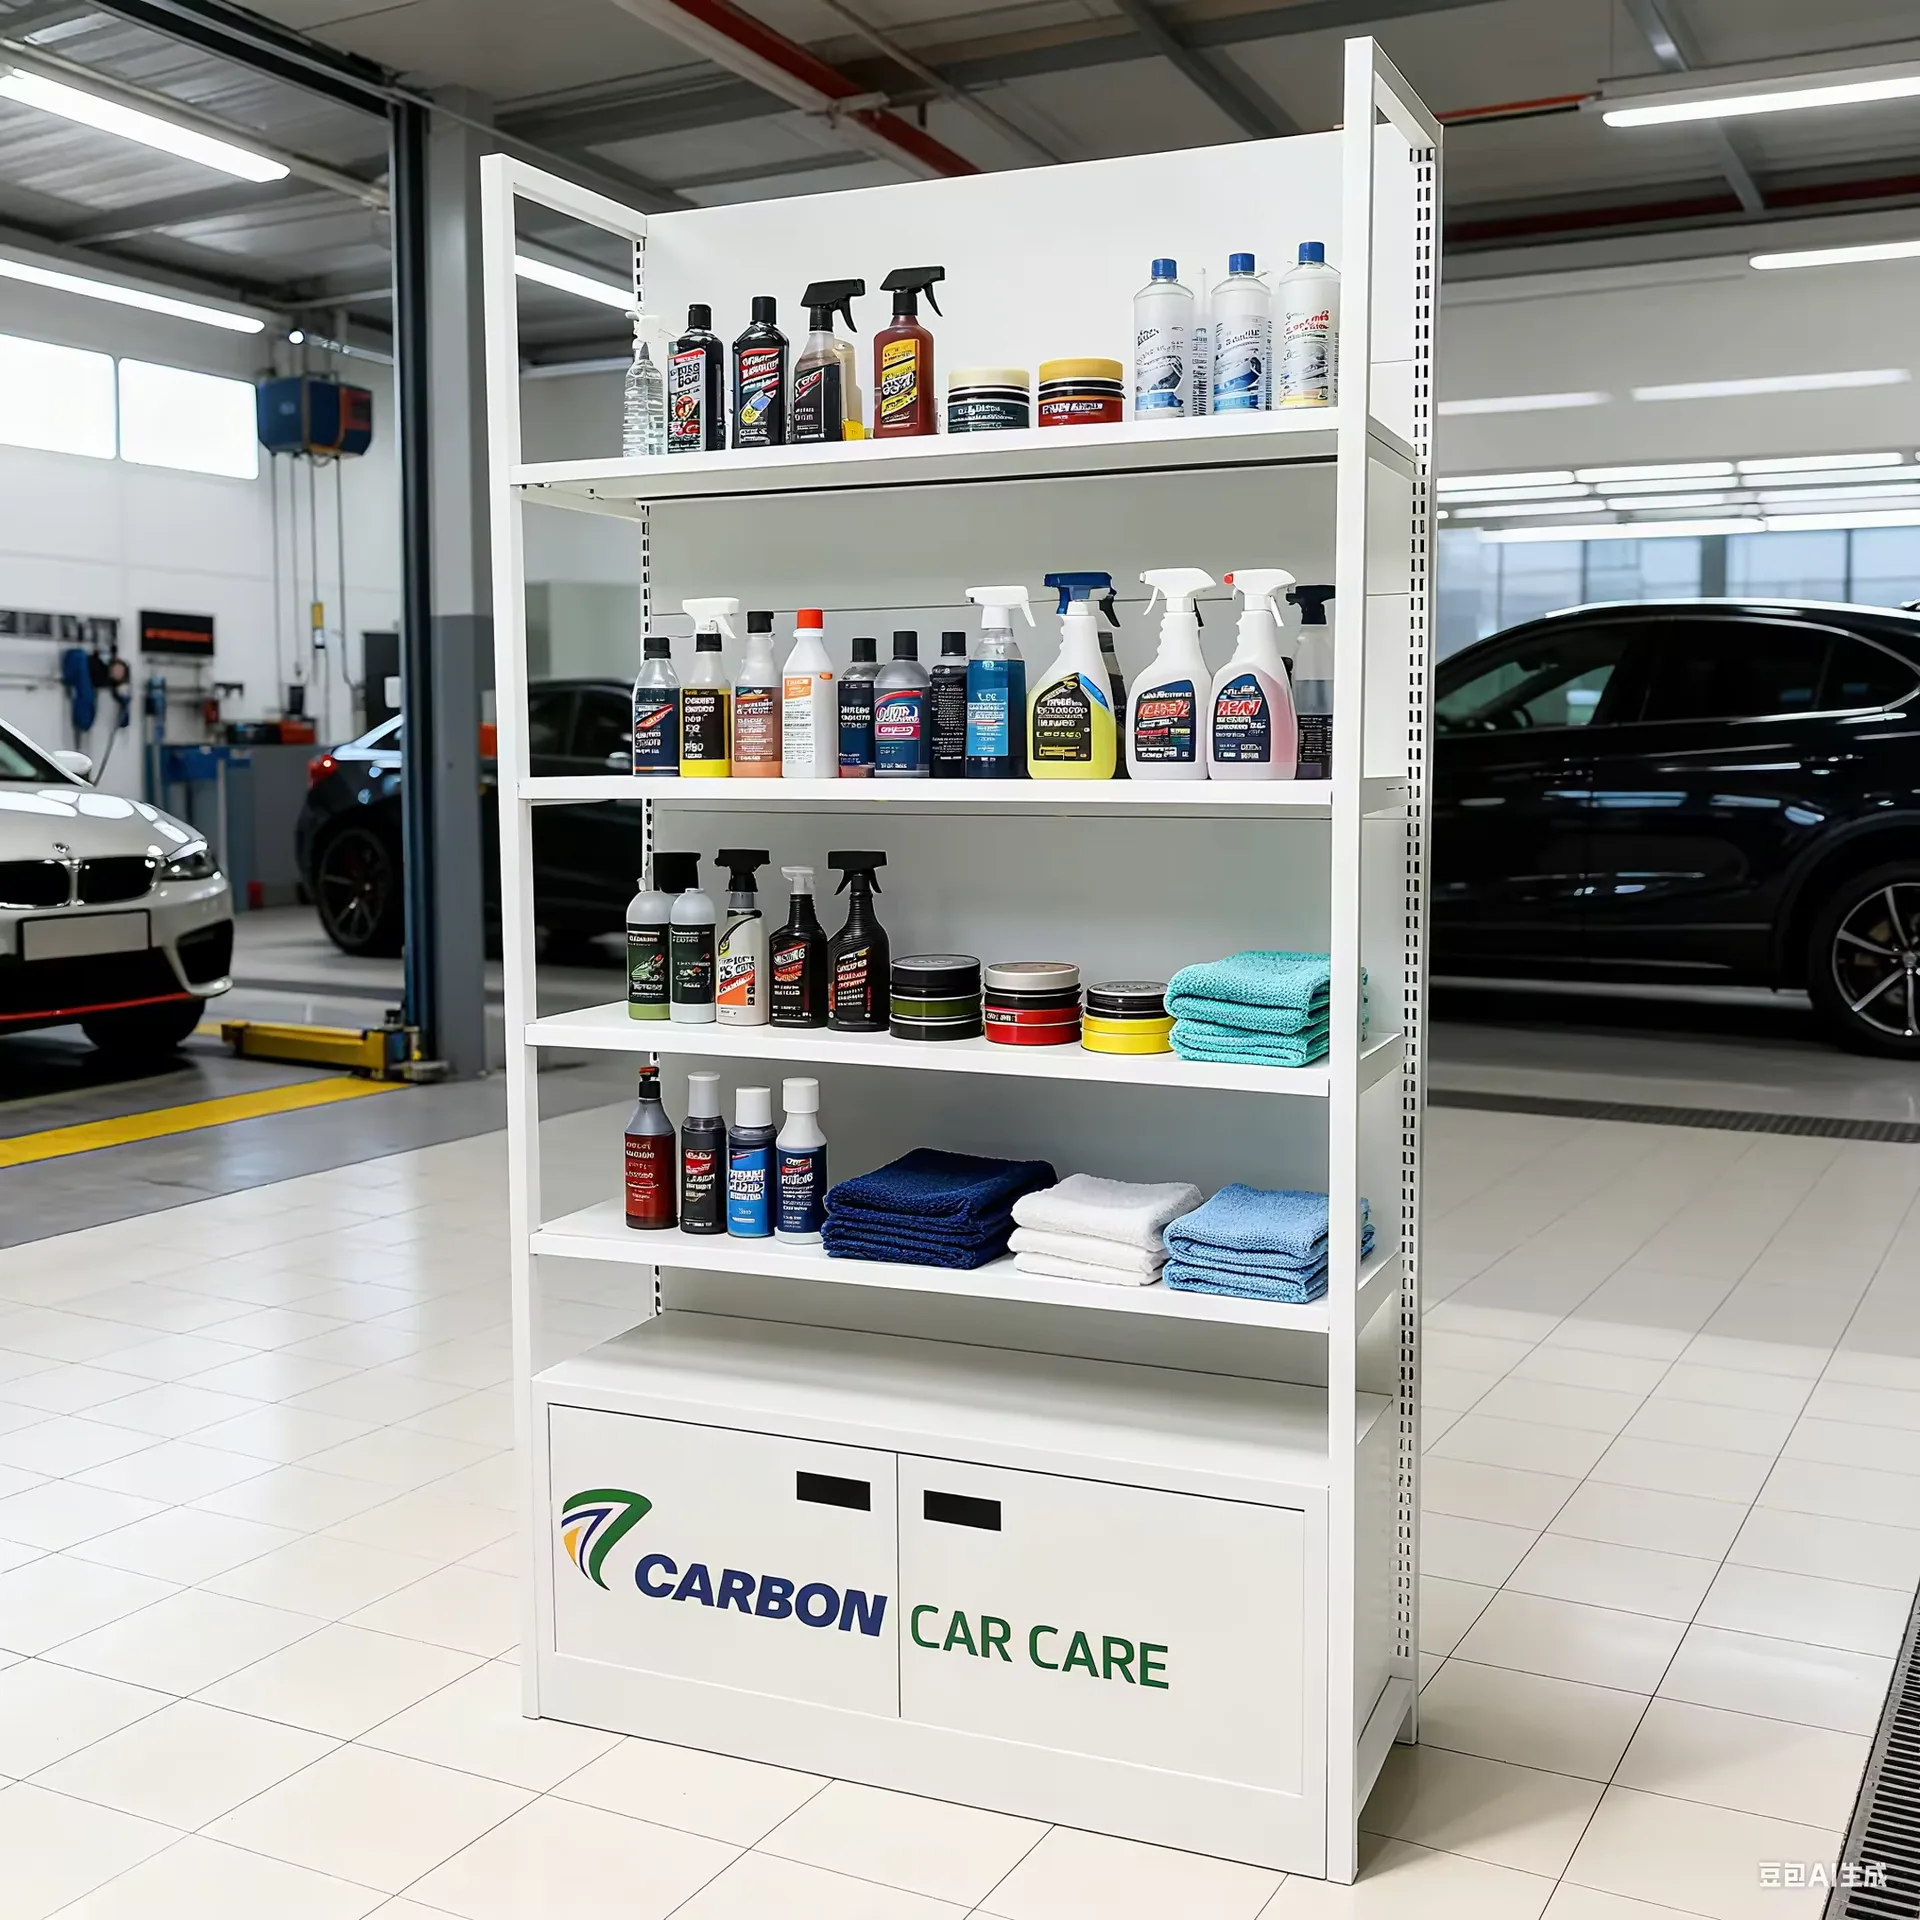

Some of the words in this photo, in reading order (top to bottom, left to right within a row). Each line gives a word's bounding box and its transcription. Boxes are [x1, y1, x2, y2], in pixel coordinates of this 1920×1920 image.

[634, 1553, 887, 1637] CARBON
[911, 1604, 1012, 1663] CAR
[1028, 1625, 1170, 1690] CARE
